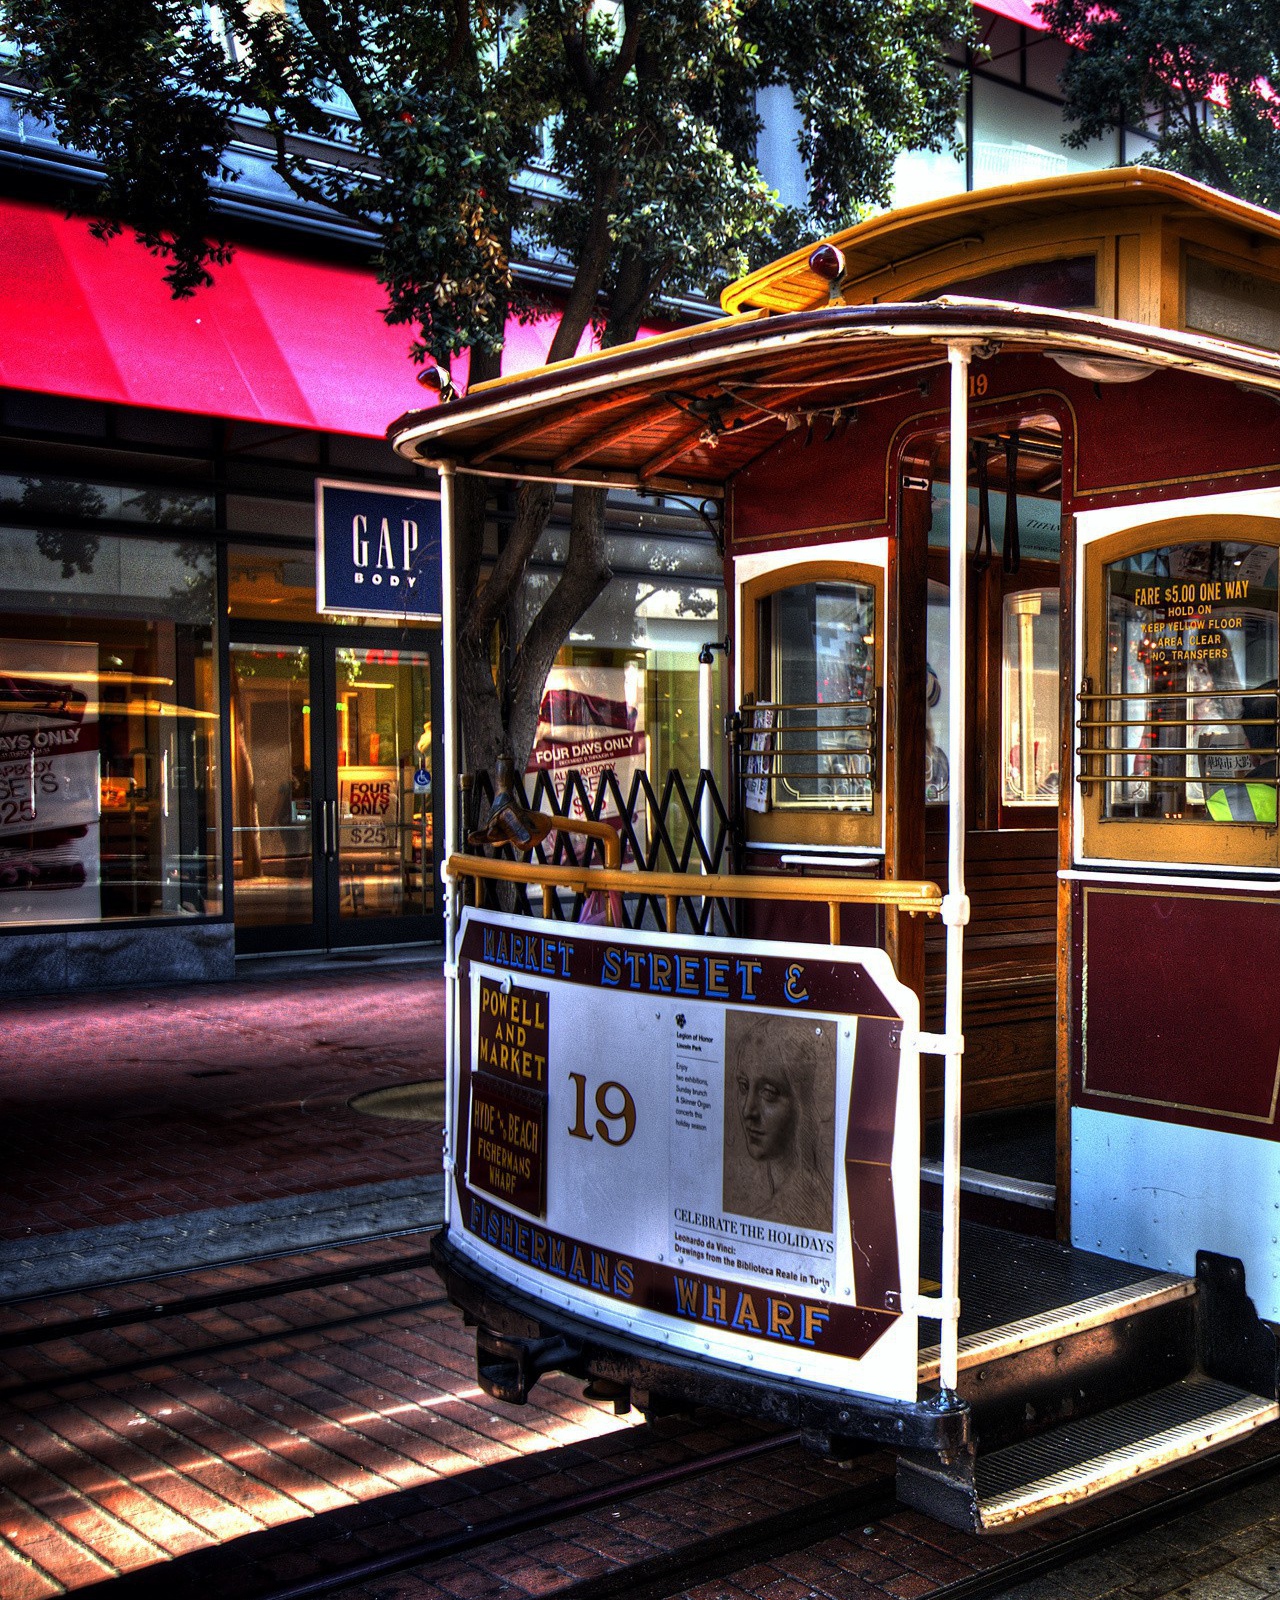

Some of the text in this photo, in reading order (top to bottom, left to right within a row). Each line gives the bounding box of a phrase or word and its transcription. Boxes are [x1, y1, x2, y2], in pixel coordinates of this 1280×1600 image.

[968, 373, 988, 398] 19
[352, 514, 418, 571] GAP
[354, 573, 417, 588] BODY
[1135, 580, 1249, 606] FARE $5.00 ONE WAY
[1168, 604, 1212, 617] HOLD ON
[1141, 618, 1242, 633] KEEP YELLOW FLOOR
[1158, 634, 1221, 647] AREA CLEAR
[1152, 649, 1228, 661] NO TRANSFERS
[34, 728, 82, 748] ONLY
[536, 736, 634, 763] FOUR DAYS ONLY
[350, 793, 390, 804] DAYS
[351, 783, 390, 793] FOUR
[350, 803, 390, 815] ONLY
[351, 827, 386, 844] $25
[483, 927, 575, 978] MARKET
[601, 946, 762, 1000] STREET
[482, 987, 545, 1030] POWELL
[495, 1023, 526, 1048] AND
[677, 1031, 692, 1040] Legion
[698, 1034, 714, 1043] Honor
[480, 1036, 546, 1082] MARKET
[676, 1062, 688, 1072] Enjoy
[676, 1085, 707, 1097] Sunday brunch
[568, 1071, 637, 1147] 19
[676, 1109, 694, 1118] concerts
[697, 1100, 711, 1110] Organ
[474, 1100, 495, 1135] HYDE
[508, 1112, 539, 1154] BEACH
[676, 1119, 690, 1130] holiday
[478, 1137, 531, 1179] FISHERMANS
[489, 1164, 517, 1195] WHARF
[674, 1208, 834, 1254] CELEBRATE THE HOLIDAYS
[674, 1232, 736, 1255] Leonardo da Vinci:
[470, 1197, 831, 1347] FISHERMANS WHARF
[674, 1243, 704, 1260] Drawings
[706, 1252, 722, 1263] from
[723, 1255, 735, 1267] the
[736, 1257, 774, 1276] Biblioteca
[775, 1269, 798, 1282] Reale
[799, 1273, 807, 1283] in
